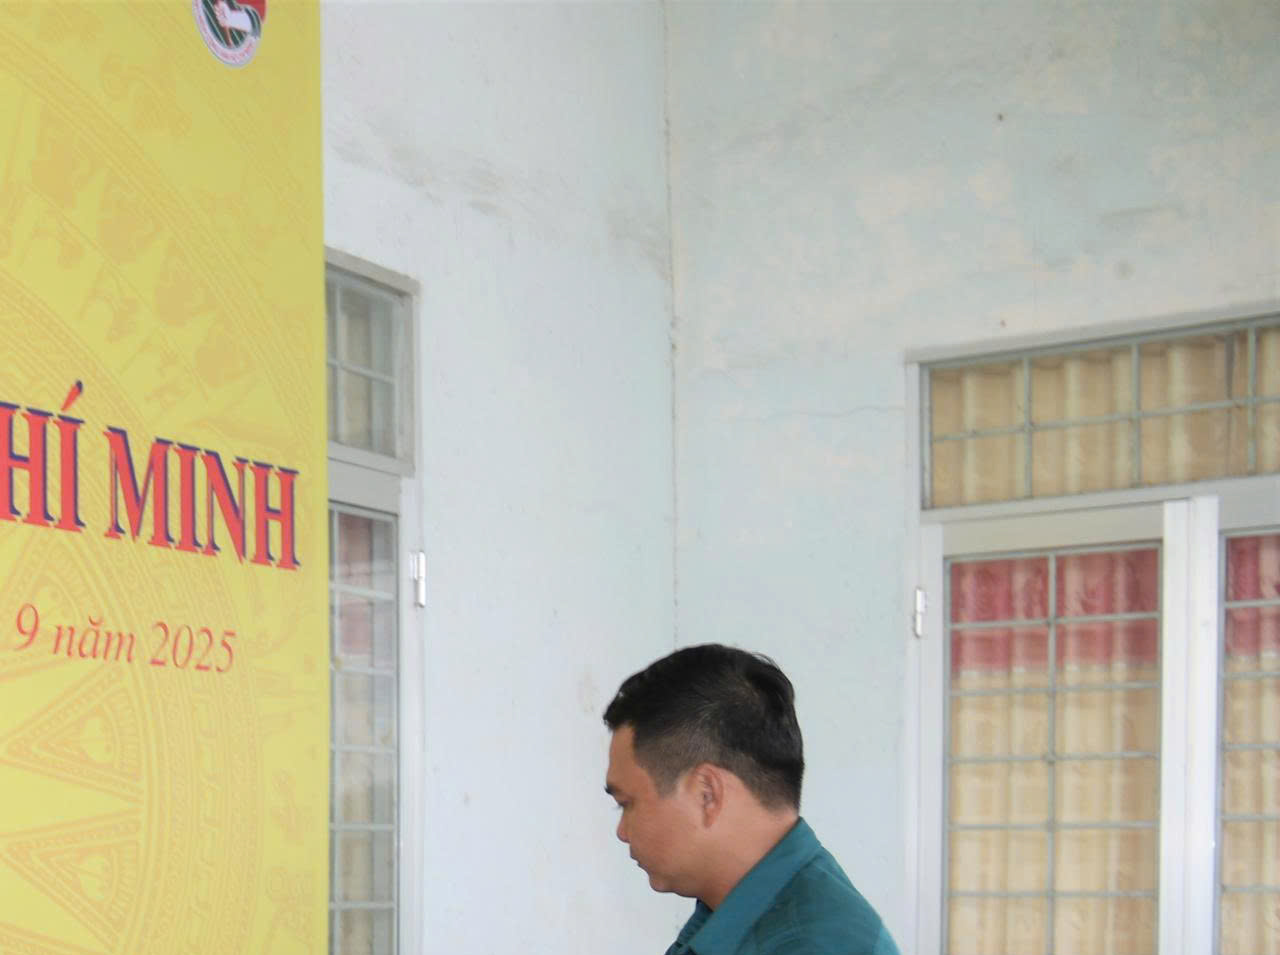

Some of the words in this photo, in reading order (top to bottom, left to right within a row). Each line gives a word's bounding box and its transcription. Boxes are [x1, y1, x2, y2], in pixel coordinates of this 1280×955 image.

[104, 428, 300, 570] MINH
[14, 602, 41, 652] 9
[52, 615, 136, 664] năm
[149, 620, 237, 674] 2025
